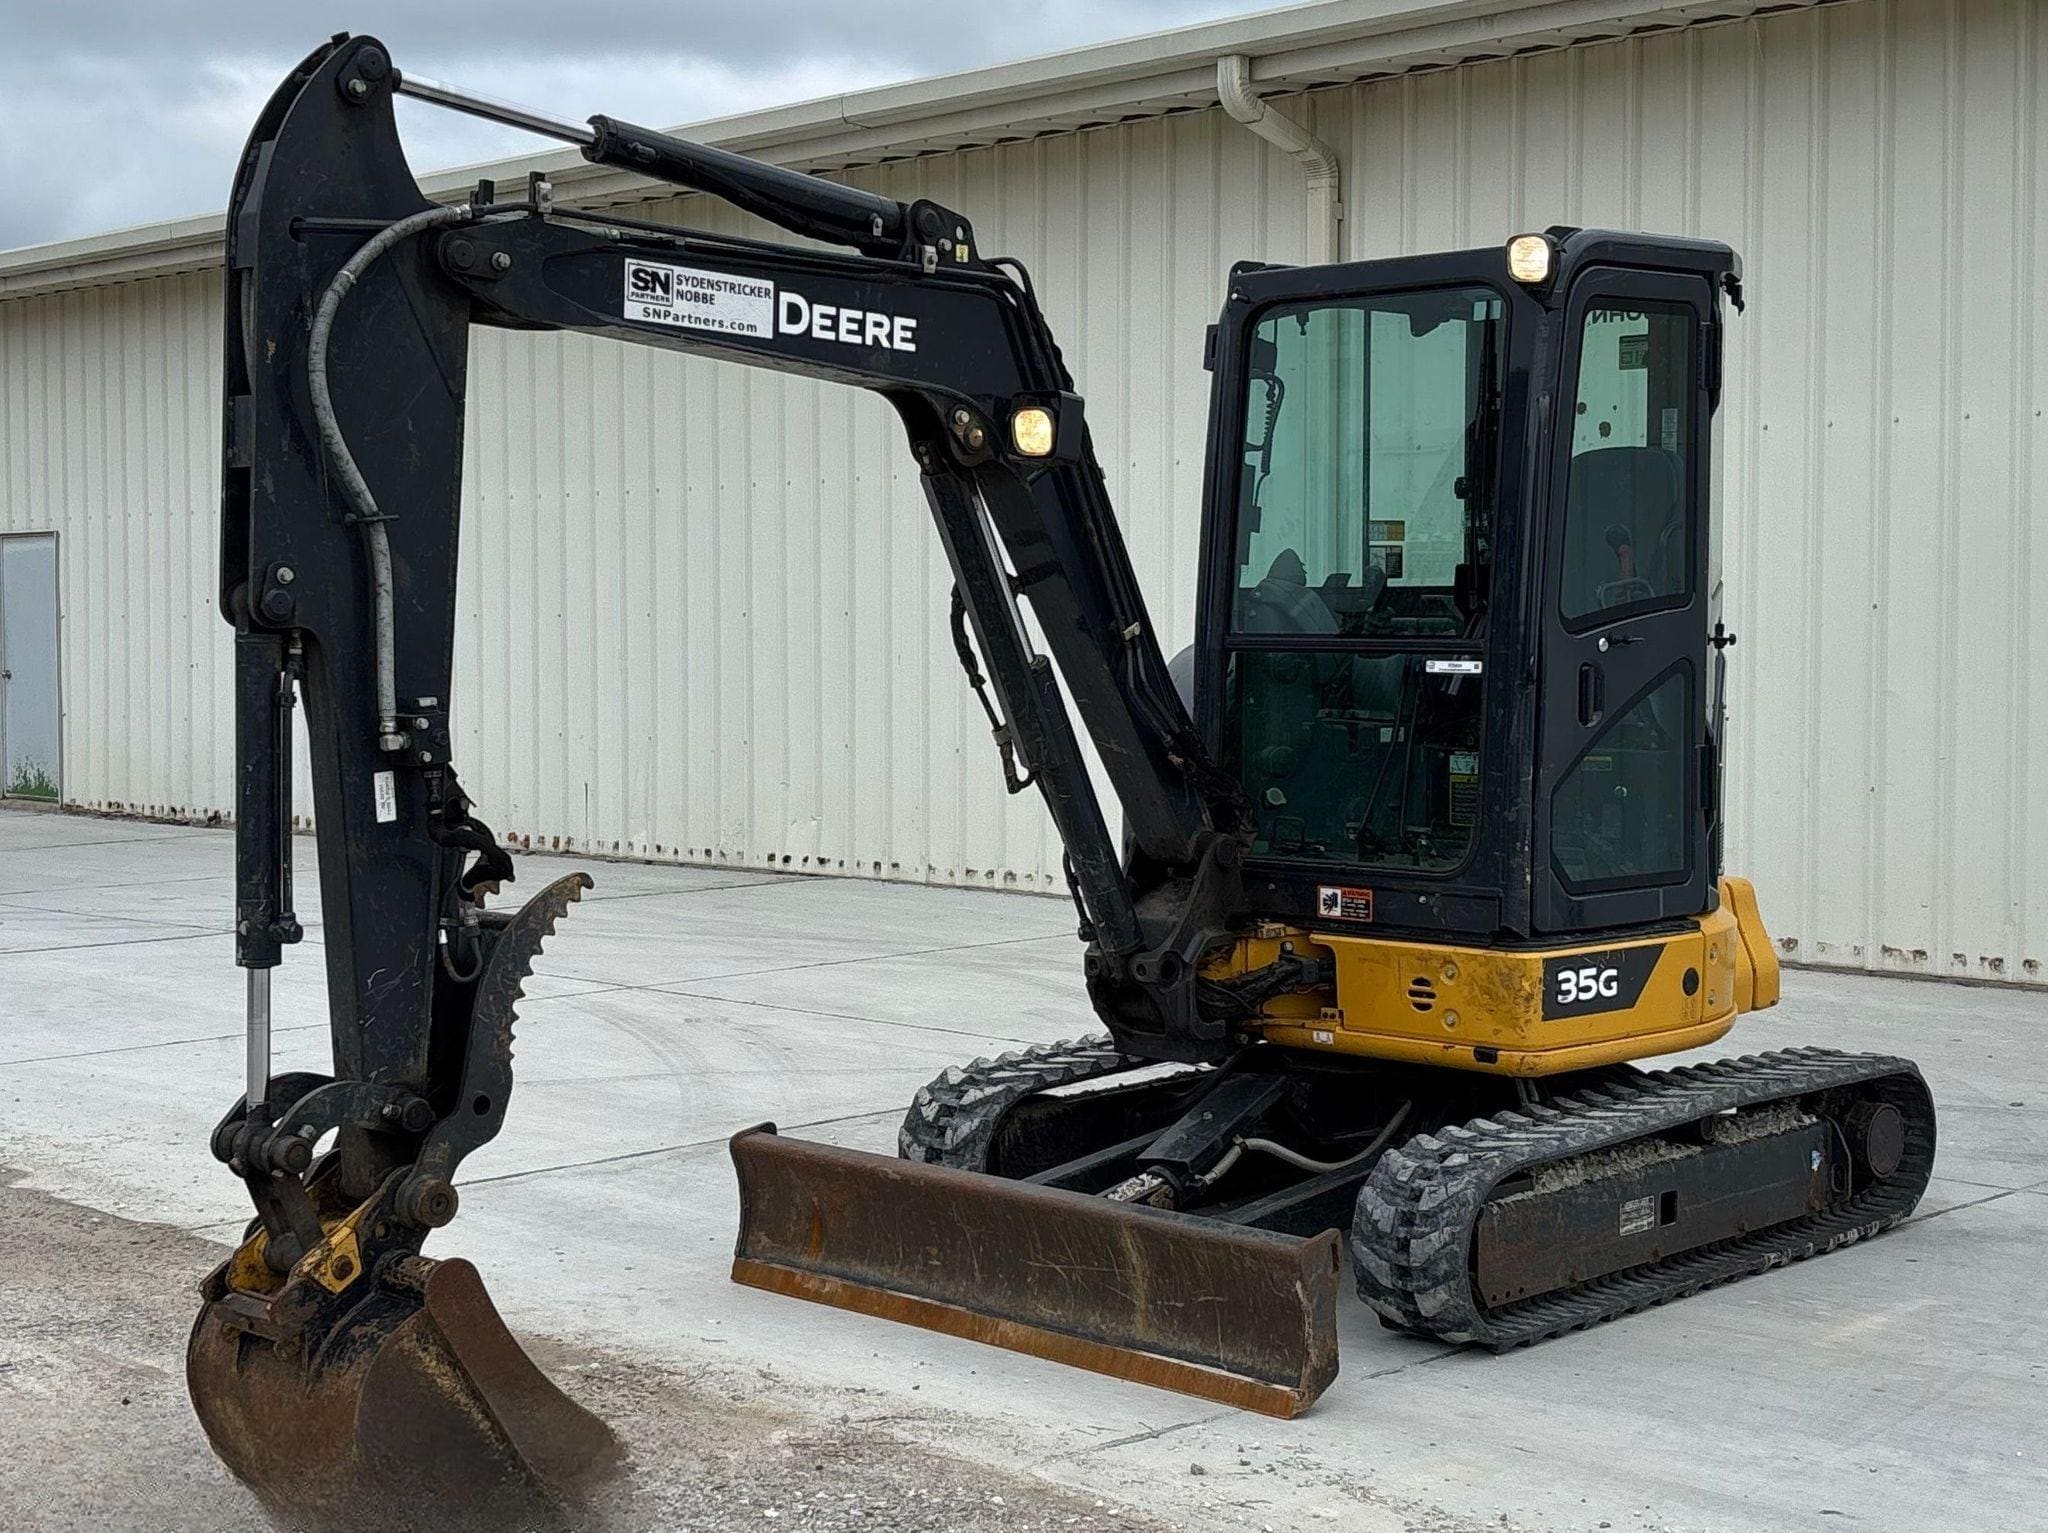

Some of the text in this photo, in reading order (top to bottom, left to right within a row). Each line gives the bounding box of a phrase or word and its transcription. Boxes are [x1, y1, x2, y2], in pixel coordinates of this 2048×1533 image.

[631, 267, 670, 295] SN
[676, 274, 771, 299] SYDENSTRICKER
[676, 289, 716, 305] NOBBE
[642, 307, 758, 333] SNPartners.com
[778, 291, 917, 351] DEERE
[1557, 966, 1618, 1004] 35G
